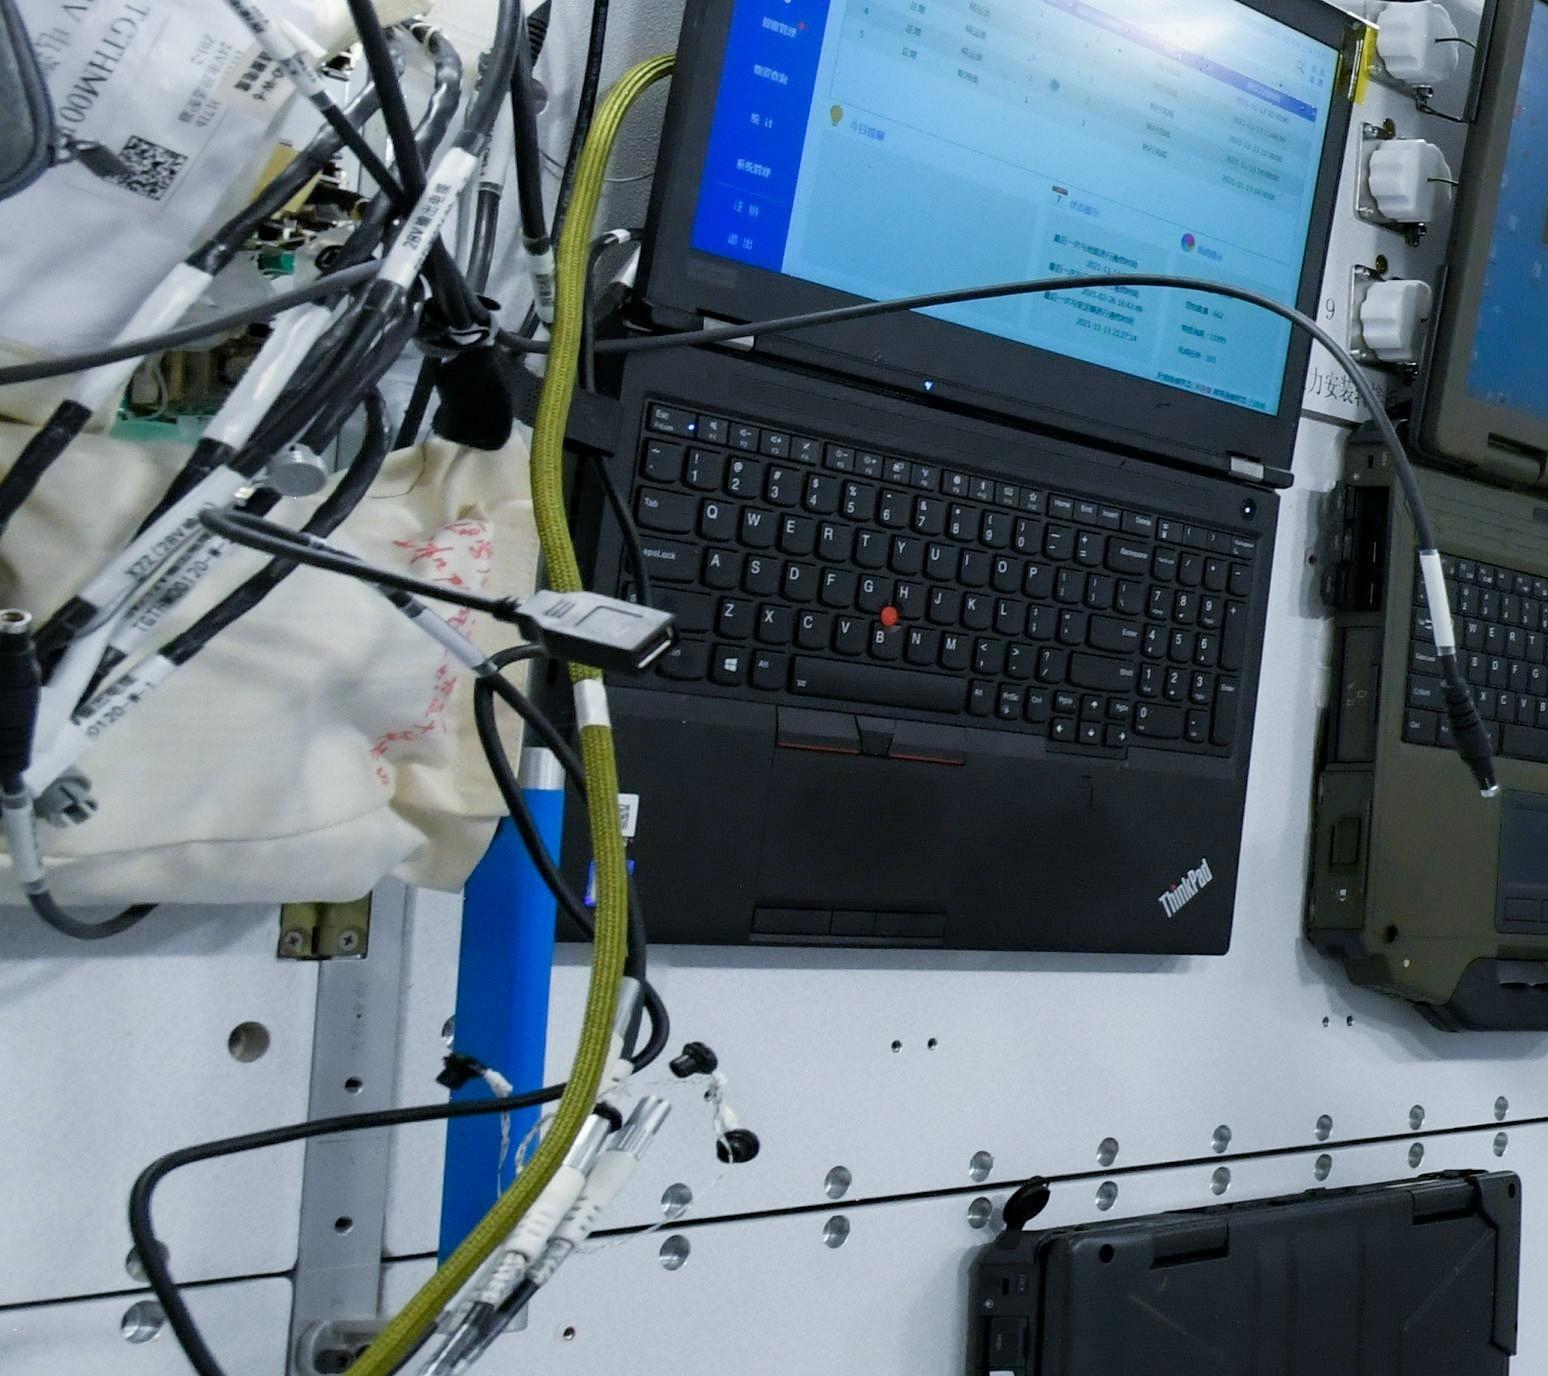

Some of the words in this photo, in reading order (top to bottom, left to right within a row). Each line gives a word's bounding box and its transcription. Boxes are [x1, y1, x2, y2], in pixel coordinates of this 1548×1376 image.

[60, 2, 150, 136] TGTHM00
[1325, 297, 1336, 321] 9
[1158, 858, 1213, 918] ThinkPad
